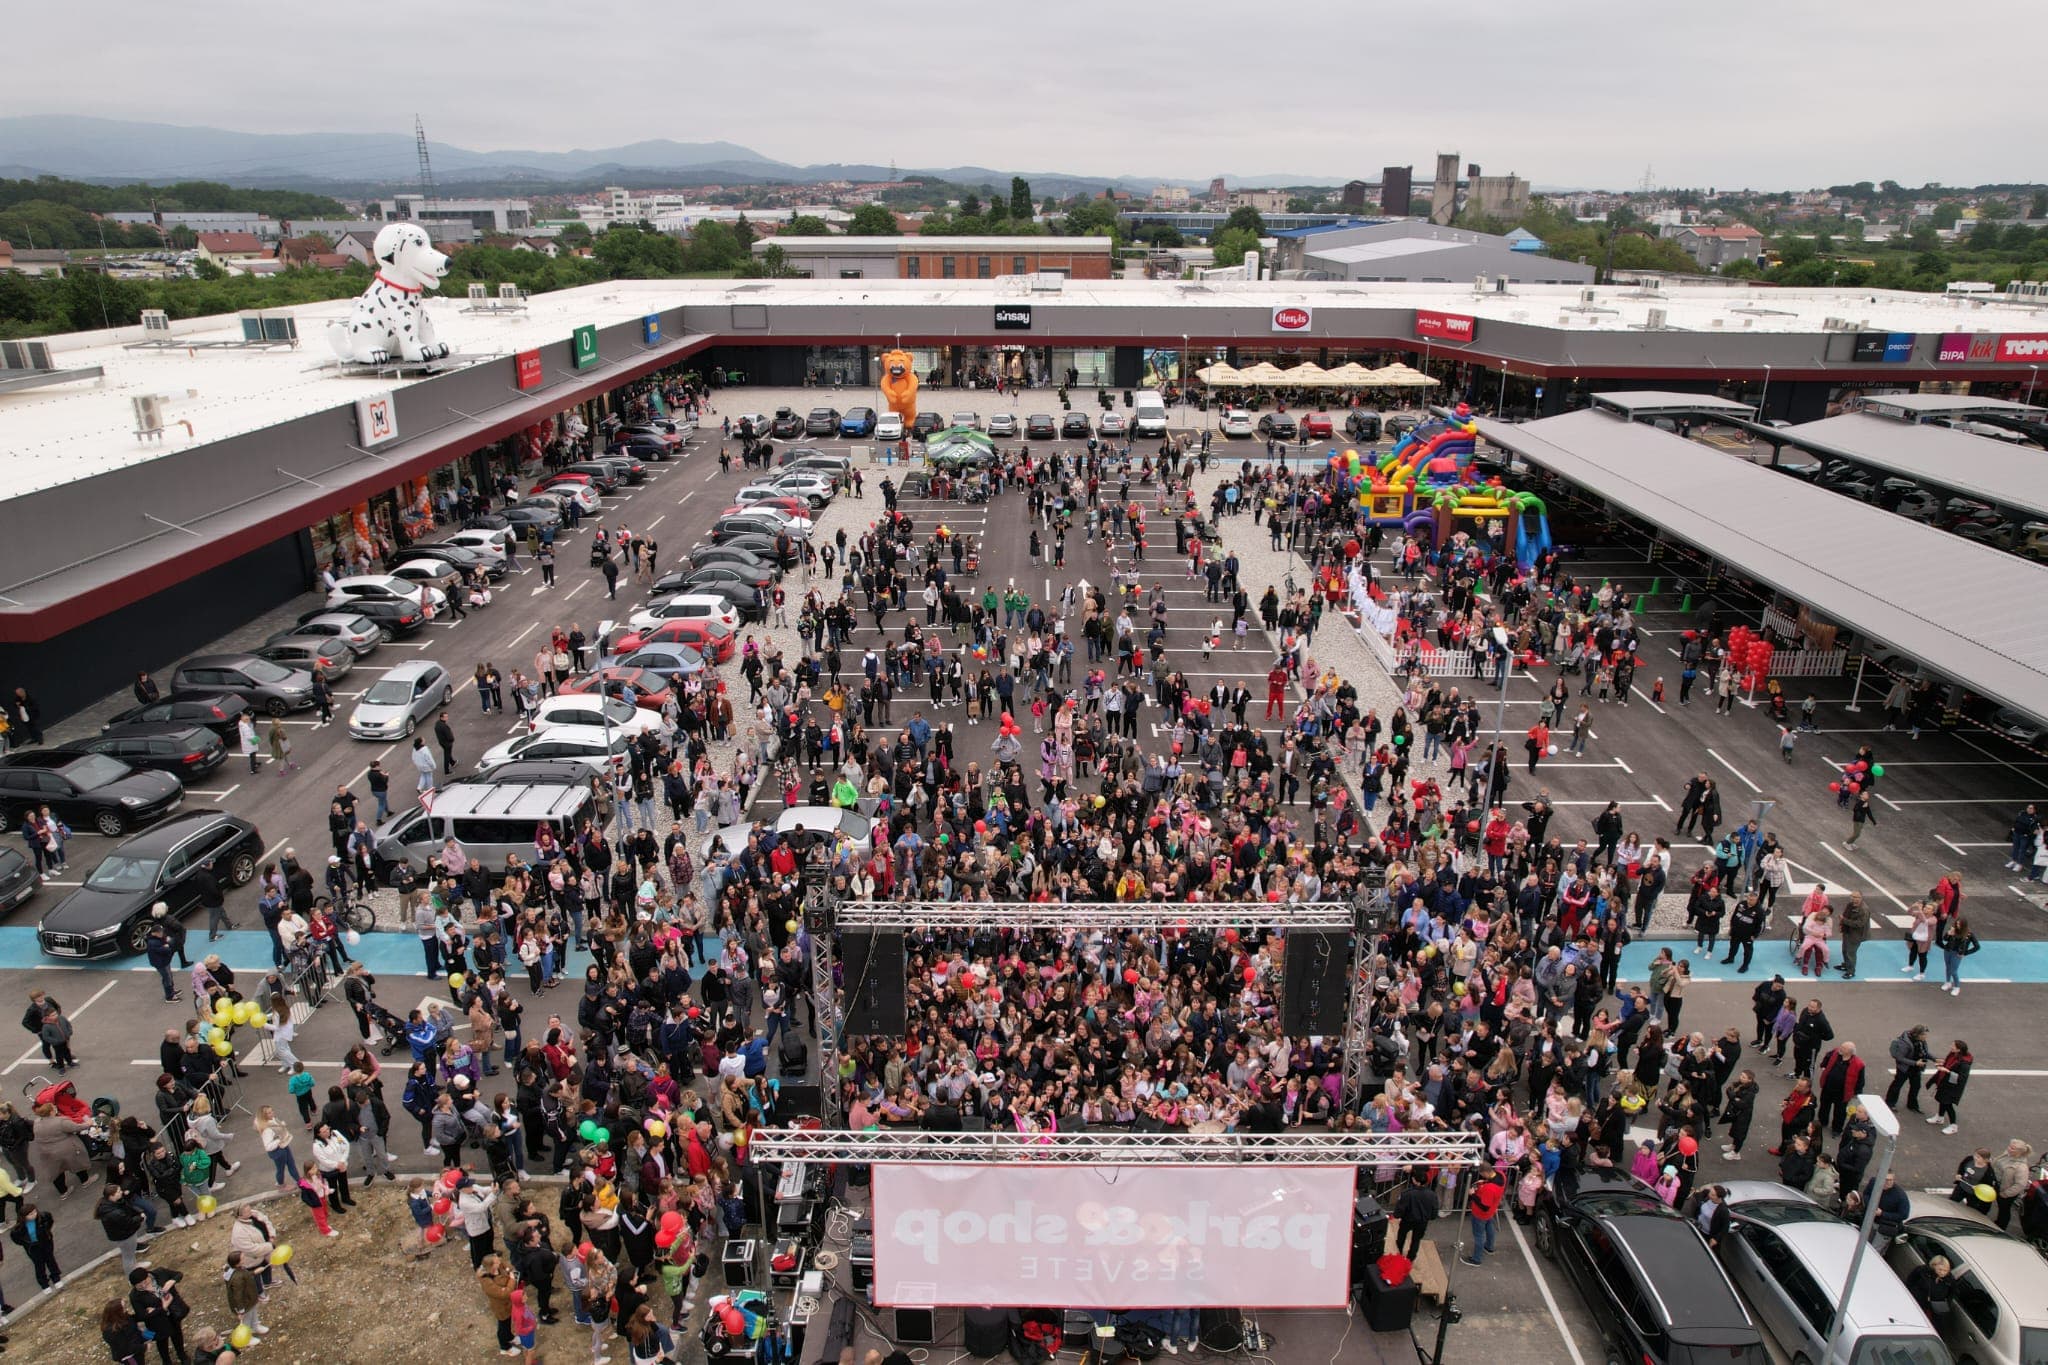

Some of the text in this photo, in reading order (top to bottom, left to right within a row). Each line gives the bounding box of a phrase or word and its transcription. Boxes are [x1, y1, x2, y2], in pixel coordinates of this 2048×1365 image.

[996, 310, 1030, 324] sinsay
[1279, 312, 1307, 325] Hervis
[1446, 317, 1471, 332] TOMMY
[582, 331, 591, 352] D
[1939, 350, 1965, 361] BIPA
[374, 410, 385, 427] M
